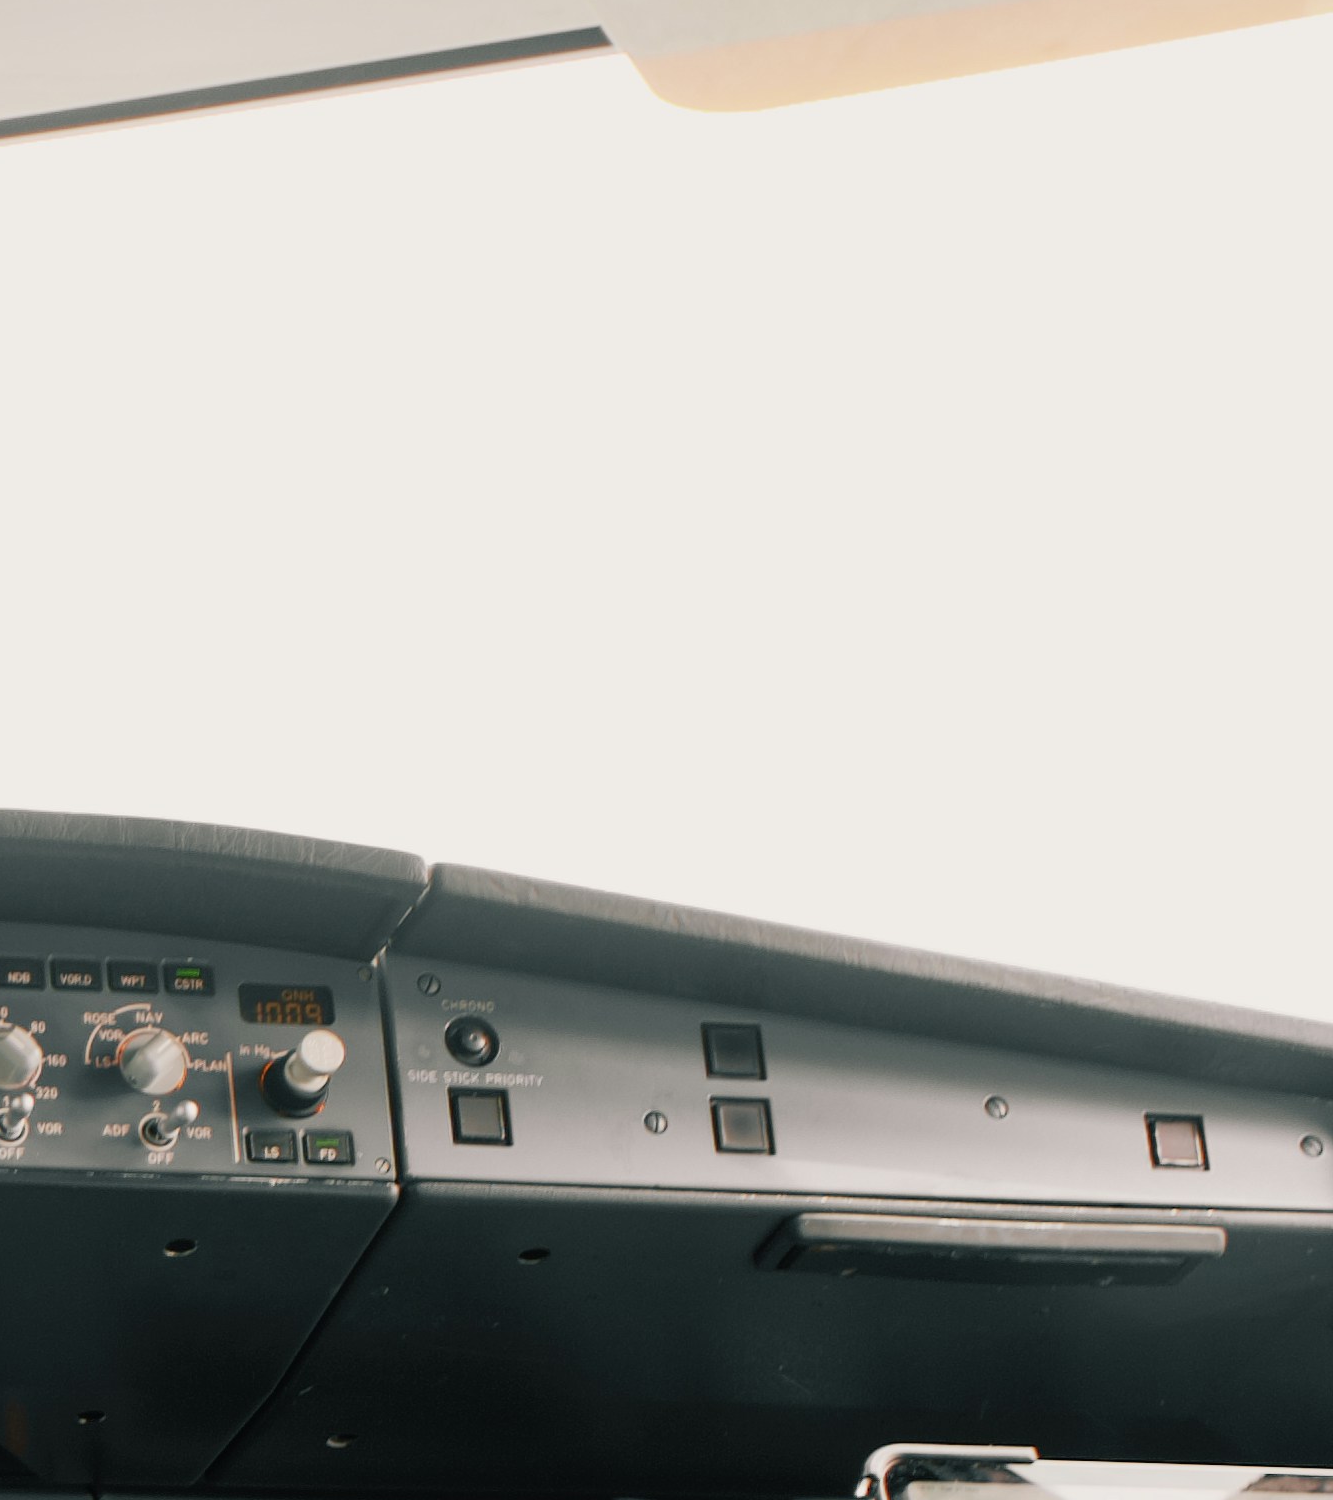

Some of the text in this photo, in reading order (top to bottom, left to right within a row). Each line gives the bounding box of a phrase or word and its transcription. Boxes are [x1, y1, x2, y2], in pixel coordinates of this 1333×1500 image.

[175, 977, 203, 990] CSTR
[442, 1000, 495, 1012] CHRONO
[407, 1071, 545, 1086] SIDE STICK PRIORITY
